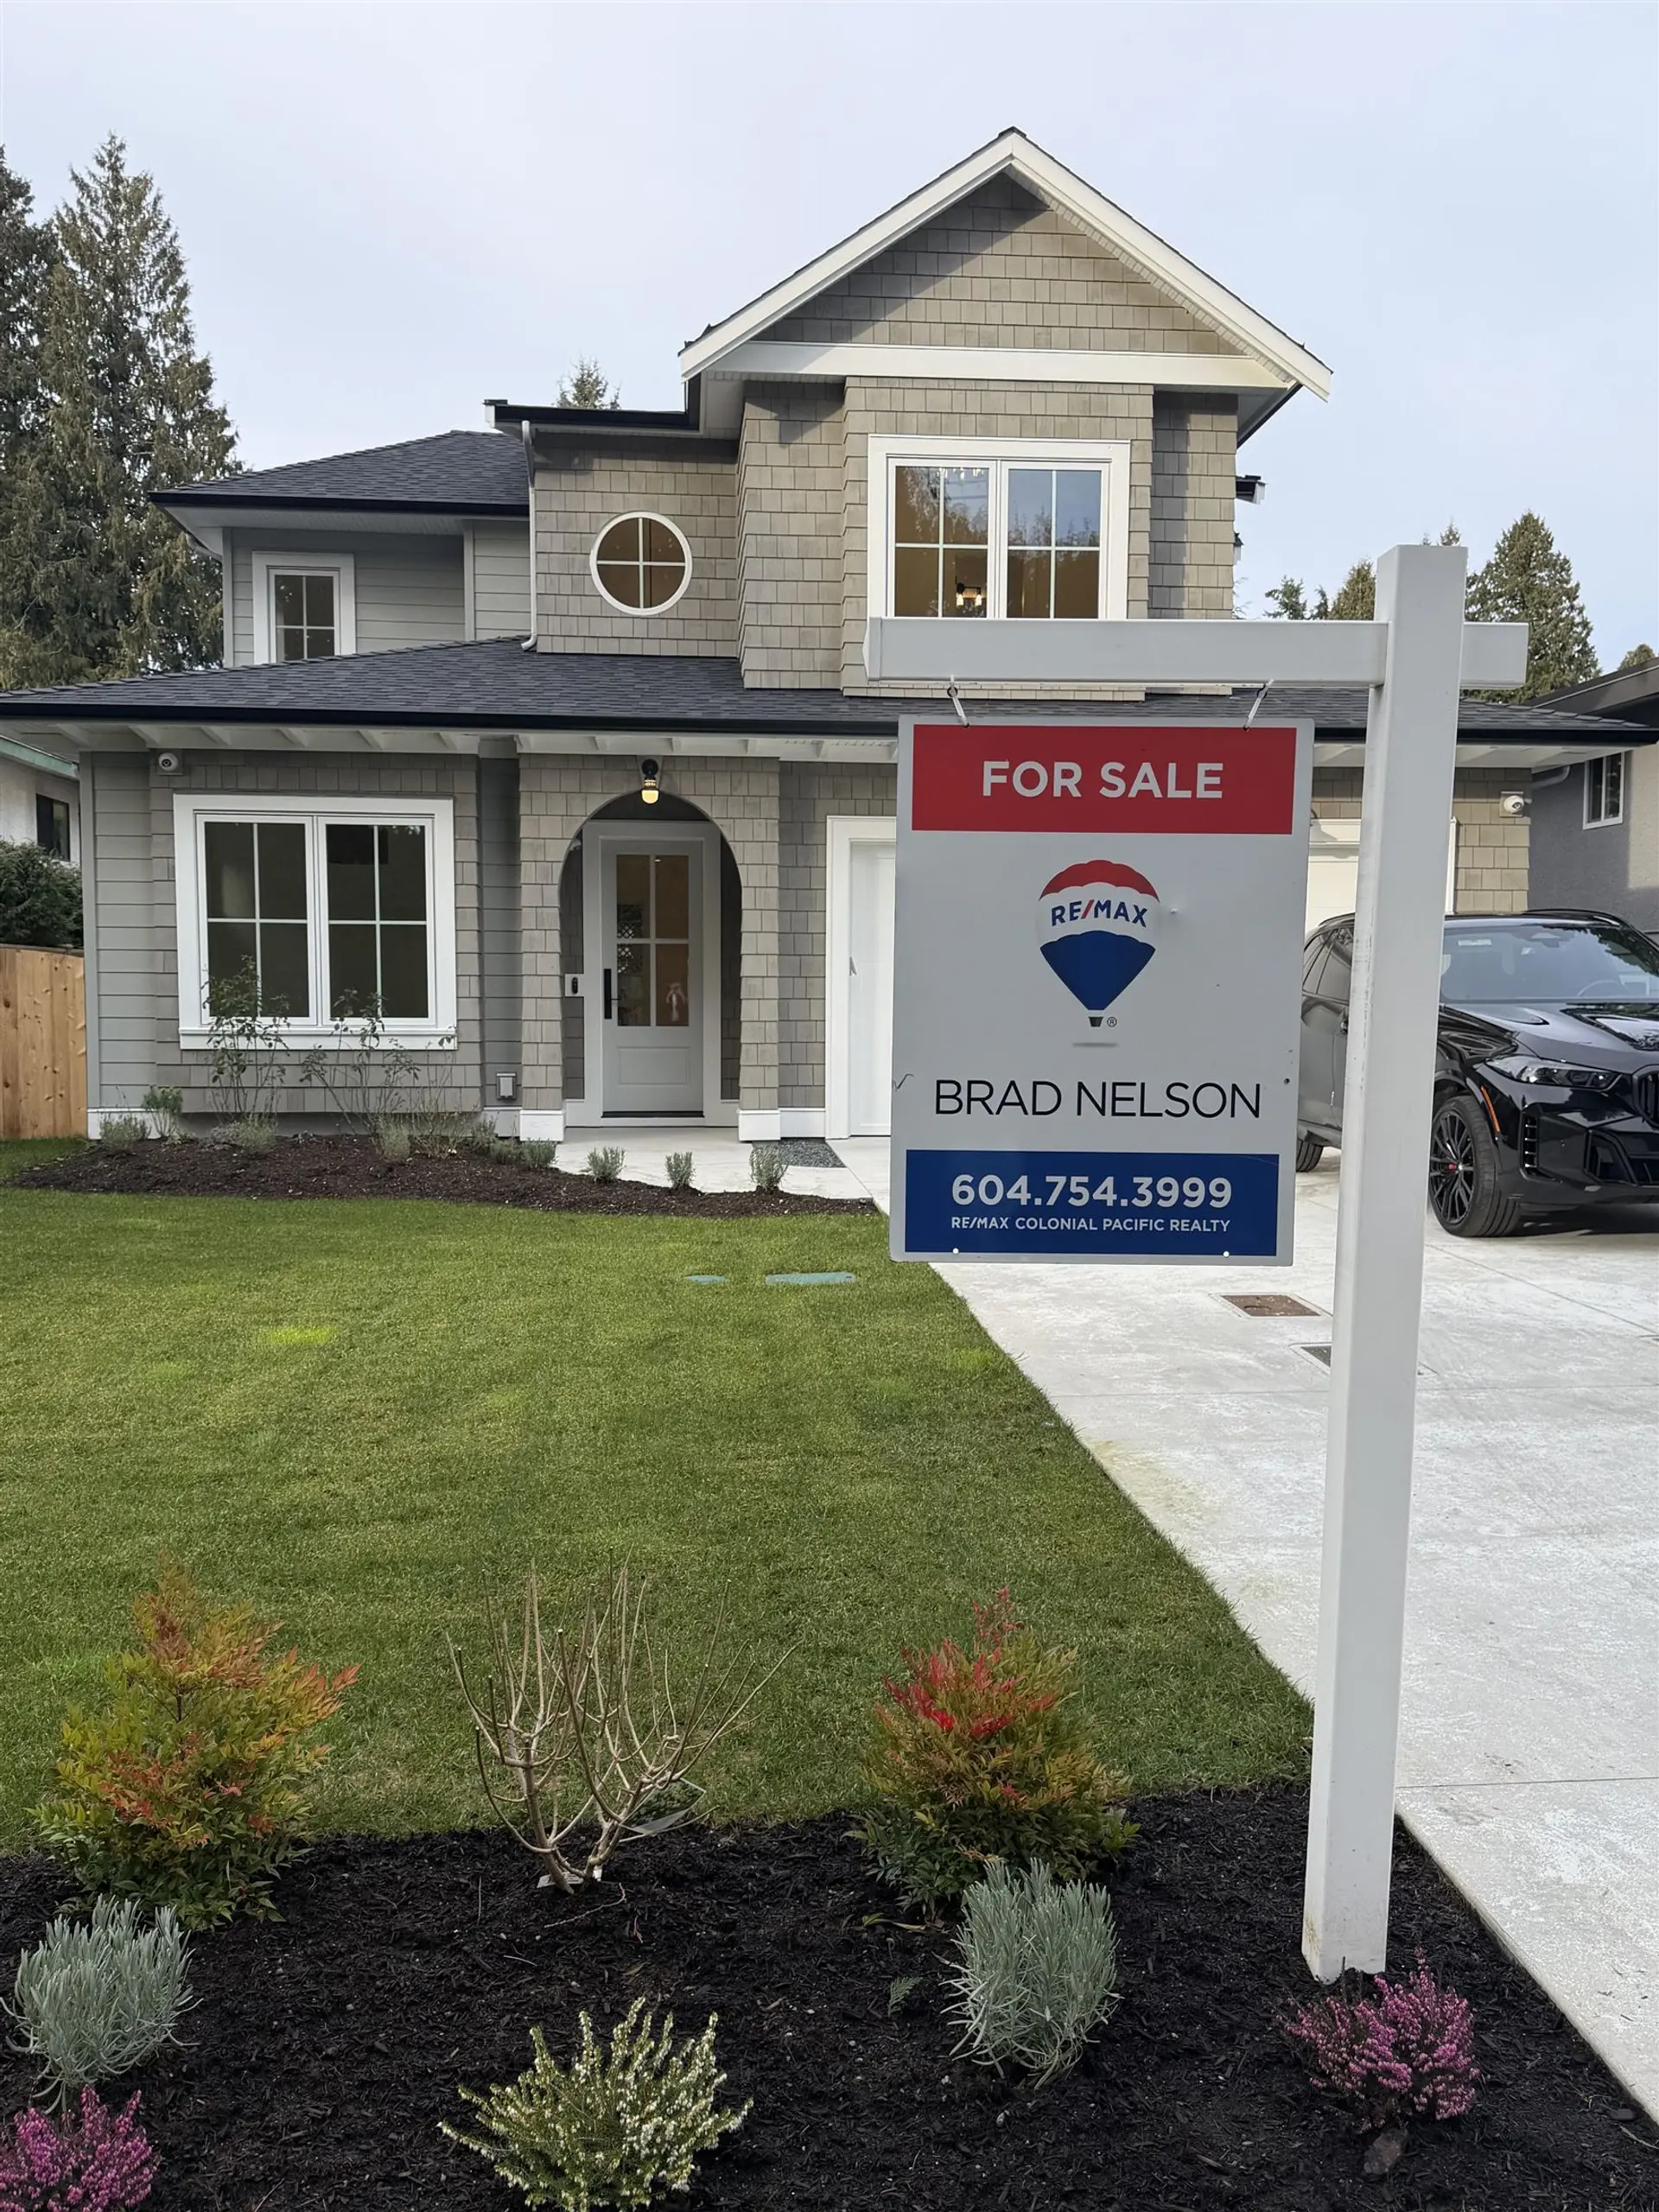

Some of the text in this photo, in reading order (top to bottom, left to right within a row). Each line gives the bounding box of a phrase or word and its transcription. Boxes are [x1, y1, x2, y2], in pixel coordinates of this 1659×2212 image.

[982, 760, 1224, 800] FOR SALE
[1051, 899, 1148, 928] RE/MAX
[934, 1079, 1261, 1119] BRAD NELSON
[951, 1173, 1233, 1209] 604.754.3999
[950, 1216, 1230, 1233] RE/MAX COLONIAL PACIFIC REALTY
